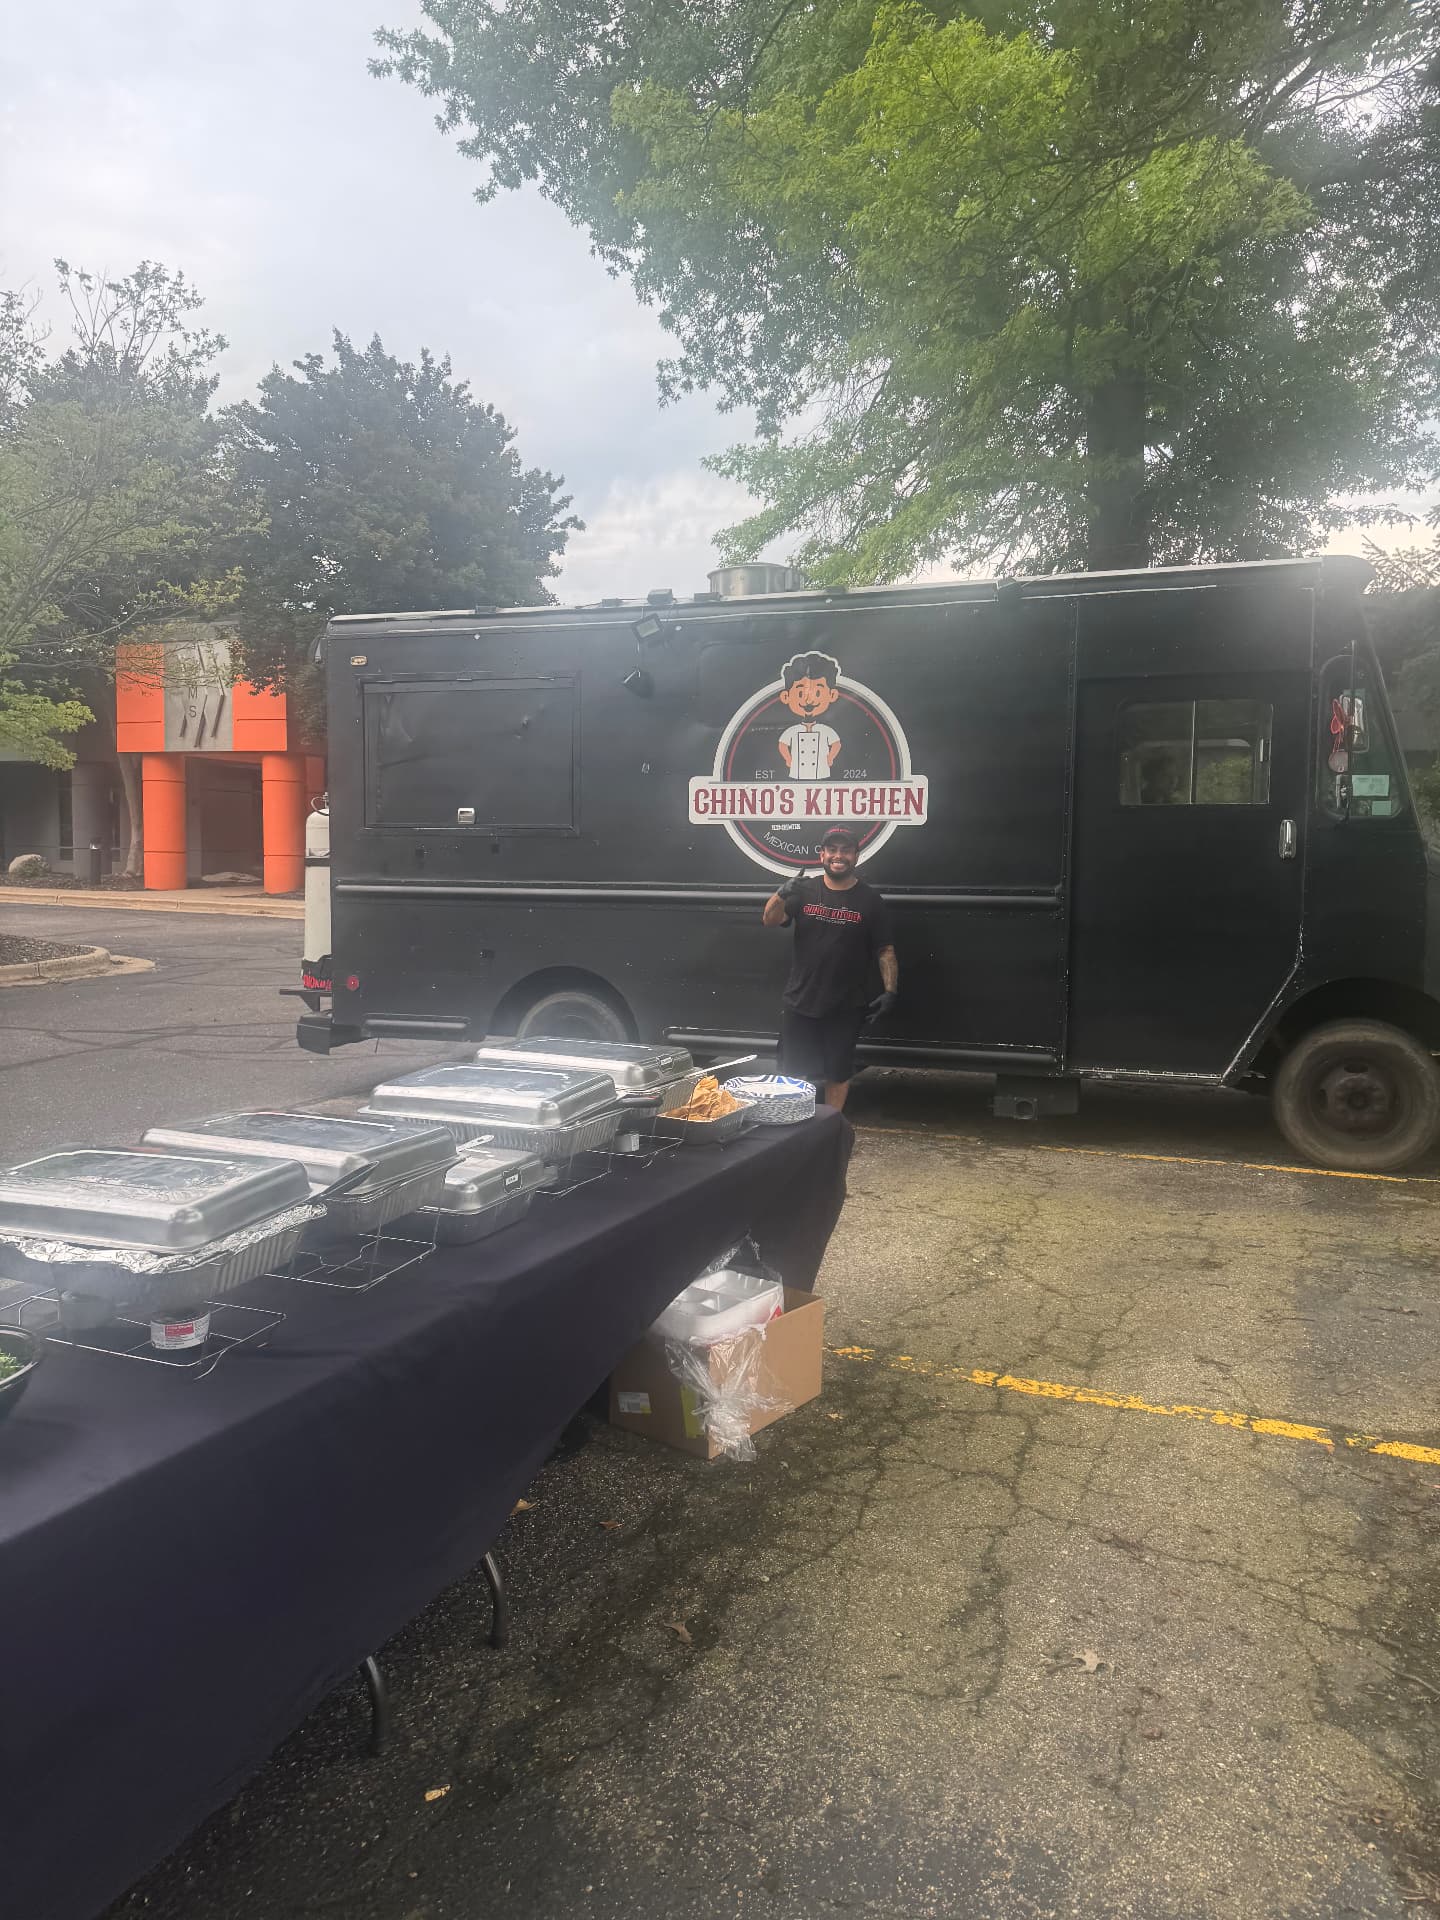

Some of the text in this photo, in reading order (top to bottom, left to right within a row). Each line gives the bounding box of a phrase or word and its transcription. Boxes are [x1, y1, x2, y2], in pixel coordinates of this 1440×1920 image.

[755, 770, 776, 779] EST
[843, 769, 867, 779] 2024
[693, 785, 925, 816] CHINO'S KITCHEN
[763, 831, 809, 855] MEXICAN
